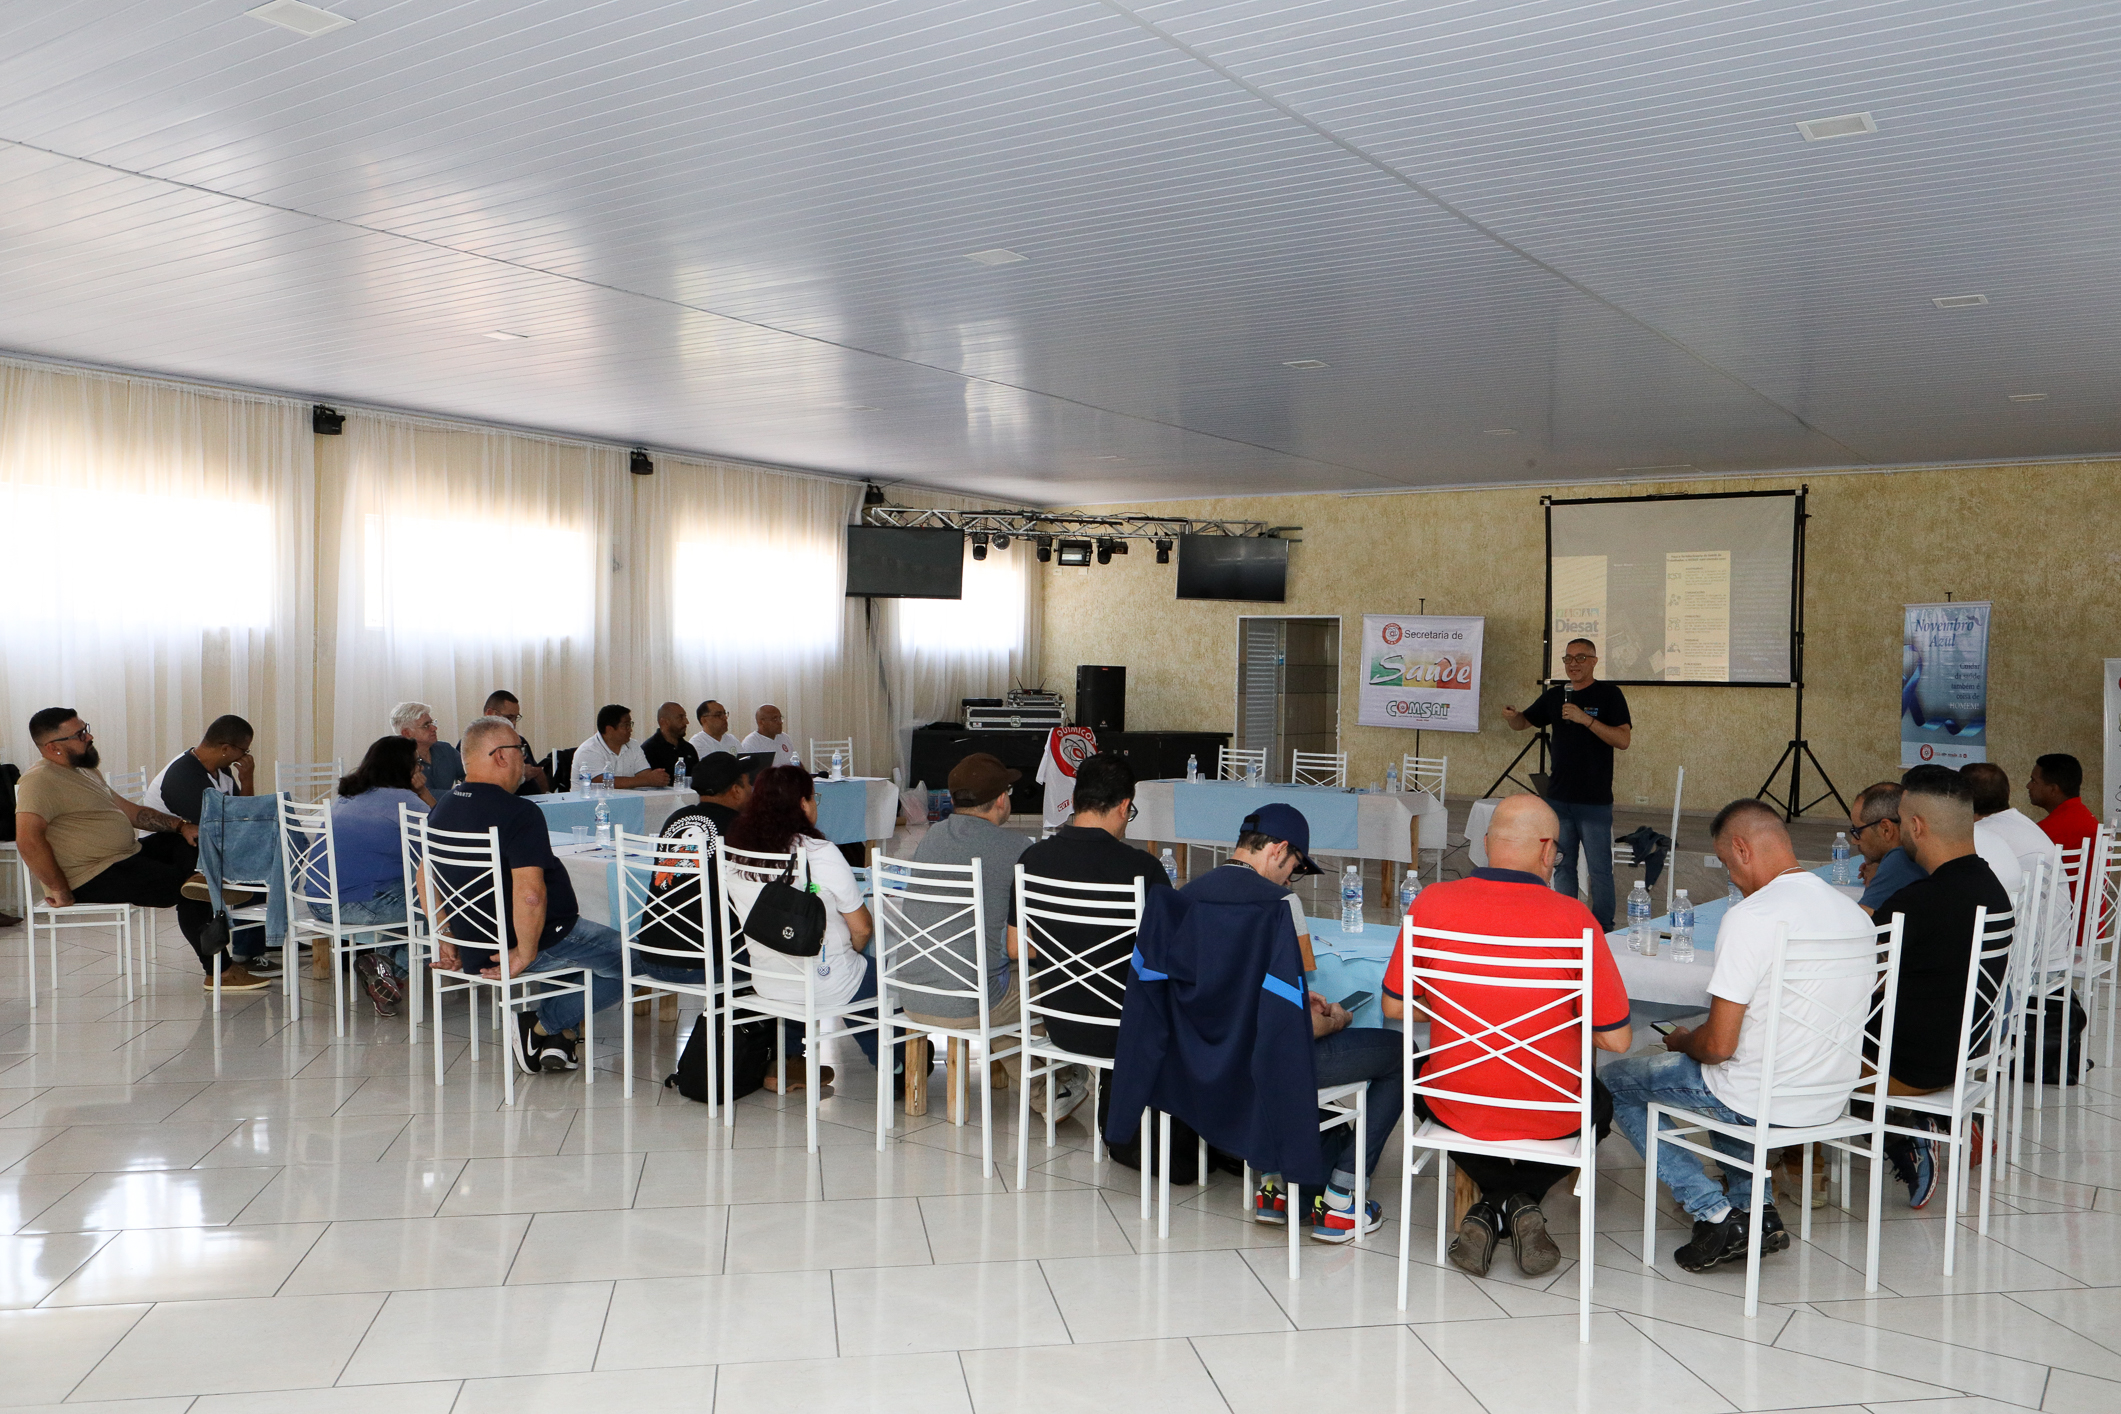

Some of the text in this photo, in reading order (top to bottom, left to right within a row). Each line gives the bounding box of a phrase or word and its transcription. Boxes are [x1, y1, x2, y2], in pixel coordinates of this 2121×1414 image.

[1555, 619, 1599, 633] Diesat
[1915, 619, 1974, 632] Novembro
[1404, 629, 1449, 640] Secretaria
[1452, 631, 1463, 640] de
[1929, 634, 1956, 648] Azul
[1972, 692, 1980, 700] de
[1386, 700, 1450, 718] COMSAT
[1057, 800, 1070, 812] CUT
